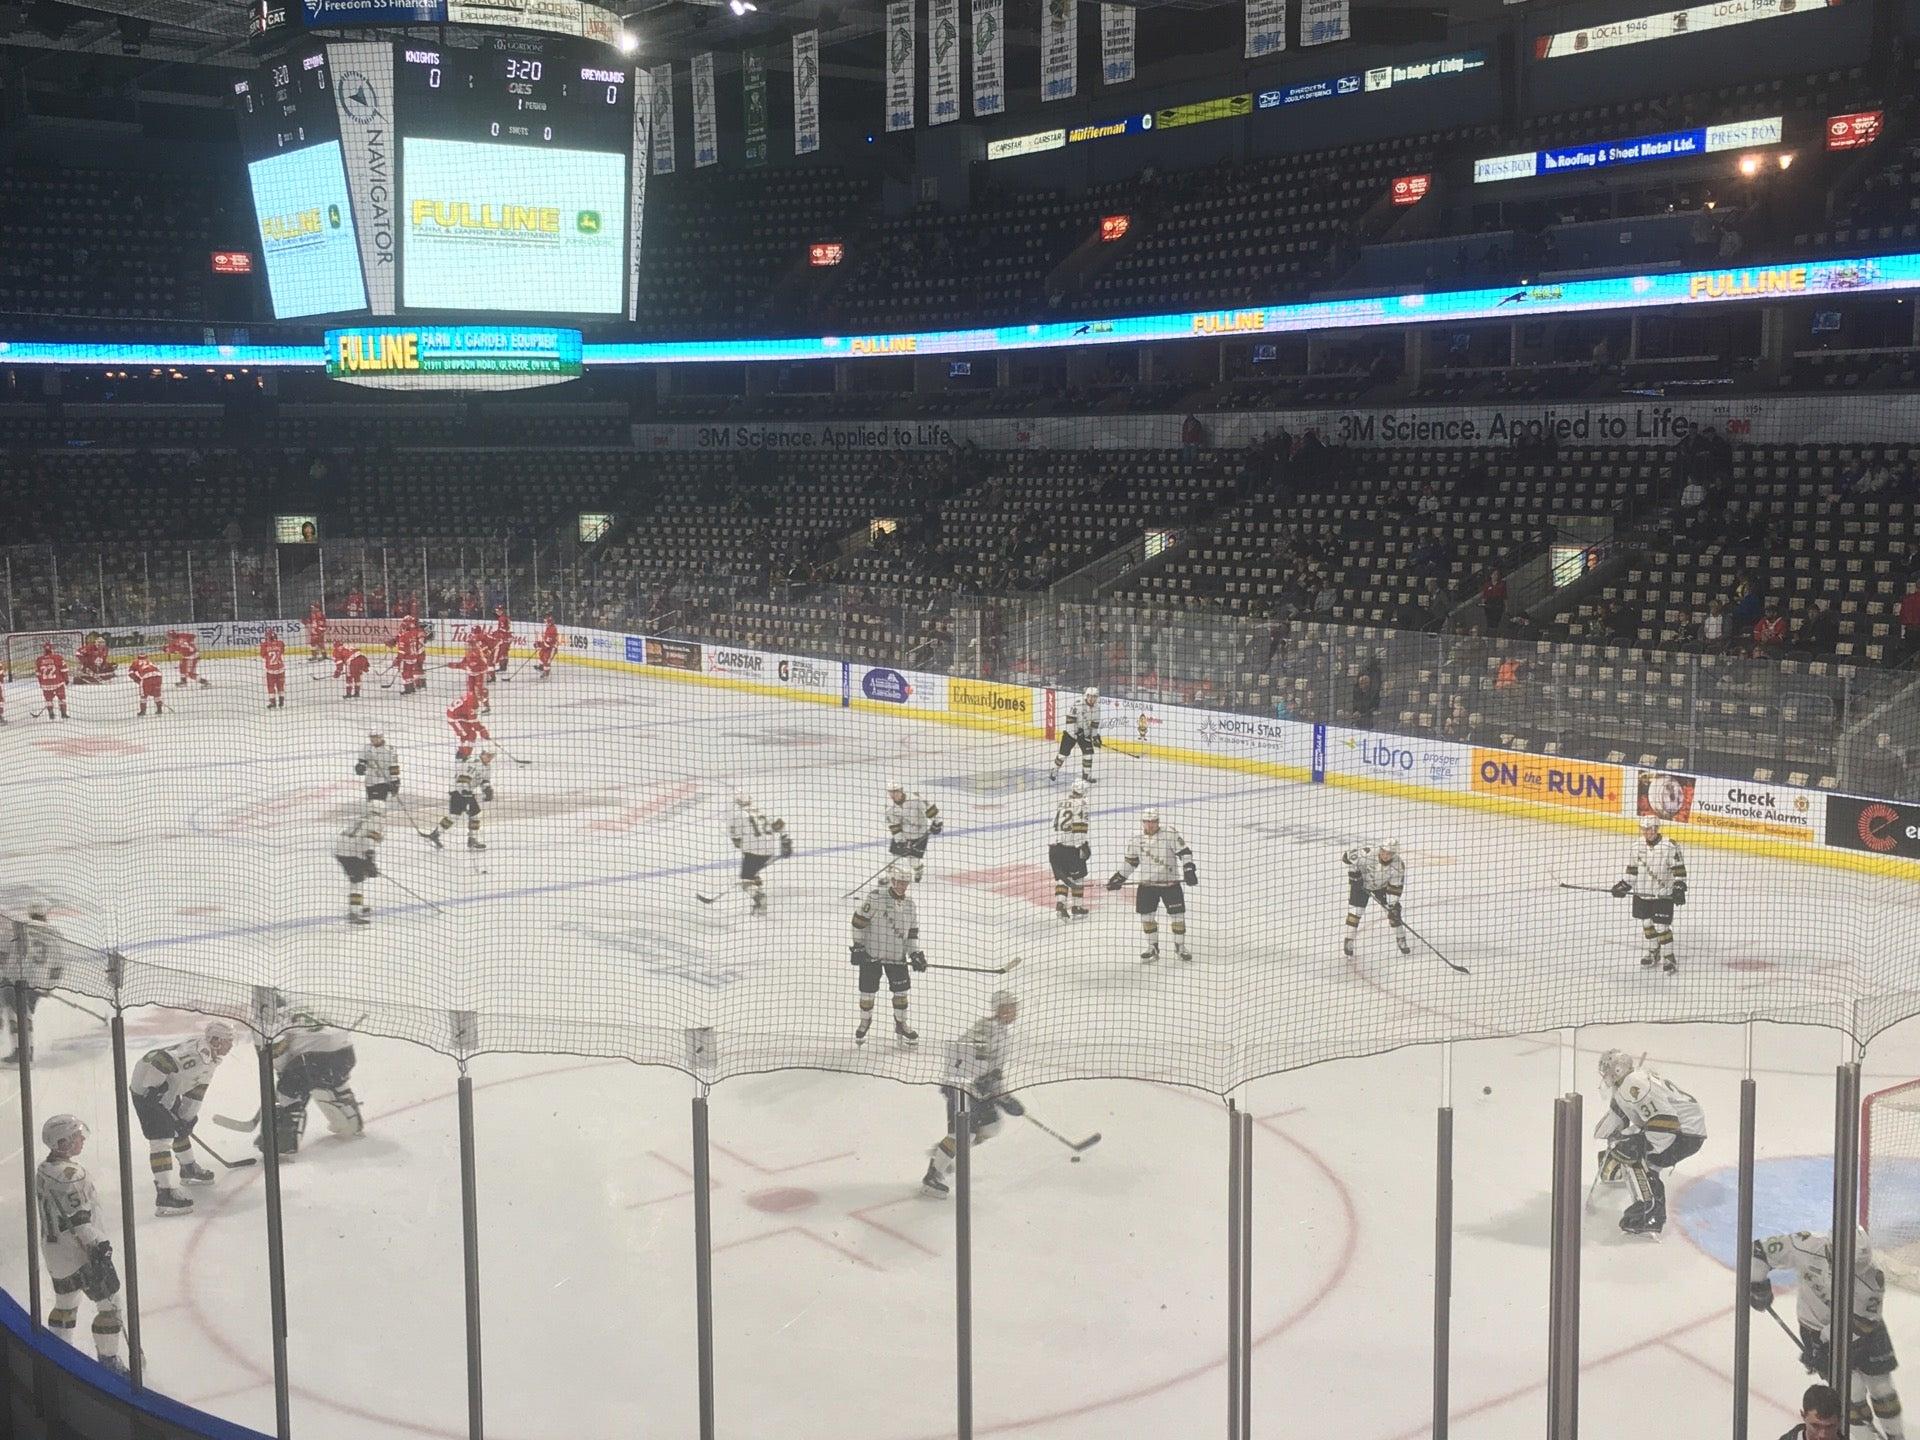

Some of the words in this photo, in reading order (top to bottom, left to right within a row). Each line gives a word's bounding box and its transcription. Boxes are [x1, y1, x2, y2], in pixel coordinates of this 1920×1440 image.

[1713, 2, 1749, 17] LOCAL
[1591, 25, 1623, 40] LOCAL
[1626, 20, 1648, 35] 1946
[405, 50, 440, 65] KNIGHTS
[429, 68, 441, 88] 0
[506, 59, 542, 81] 3:20
[581, 68, 624, 84] GREYHOUNDS
[607, 85, 617, 104] 0
[491, 122, 500, 137] 0
[543, 126, 552, 141] 0
[1711, 129, 1748, 146] PRESS
[1751, 123, 1777, 139] BOX
[1558, 152, 1595, 167] Roofing
[1598, 150, 1607, 162] &
[1609, 145, 1639, 160] Sheet
[1641, 140, 1671, 157] Metal
[1674, 137, 1696, 152] Ltd.
[1478, 161, 1509, 177] PRESS
[1510, 158, 1534, 173] BOX
[366, 129, 393, 267] NAVIGATOR
[412, 199, 560, 233] FULLINE
[1690, 268, 1807, 299] FULLINE
[1192, 311, 1265, 335] FULLINE
[422, 332, 450, 348] FARM
[851, 337, 917, 354] FULLINE
[339, 333, 419, 370] FULLINE
[1338, 414, 1374, 442] 3M
[1381, 413, 1481, 442] Science.
[1597, 411, 1627, 440] to
[698, 427, 730, 448] 3M
[821, 424, 889, 450] Applied
[892, 427, 912, 446] to
[232, 623, 283, 636] Freedom
[717, 651, 763, 671] CARSTAR
[792, 668, 829, 688] FROST
[1219, 720, 1254, 735] NORTH
[1257, 724, 1282, 738] STAR
[1362, 738, 1414, 770] Libro
[1423, 752, 1460, 767] prosper
[1430, 764, 1451, 777] here
[1481, 760, 1518, 786] ON
[1523, 771, 1543, 786] the
[1548, 769, 1605, 800] RUN
[1727, 789, 1776, 808] Check
[1698, 800, 1724, 814] Your
[1724, 805, 1763, 821] Smoke
[1764, 810, 1807, 826] Alarms
[179, 1054, 196, 1071] 18
[1640, 1101, 1659, 1118] 31
